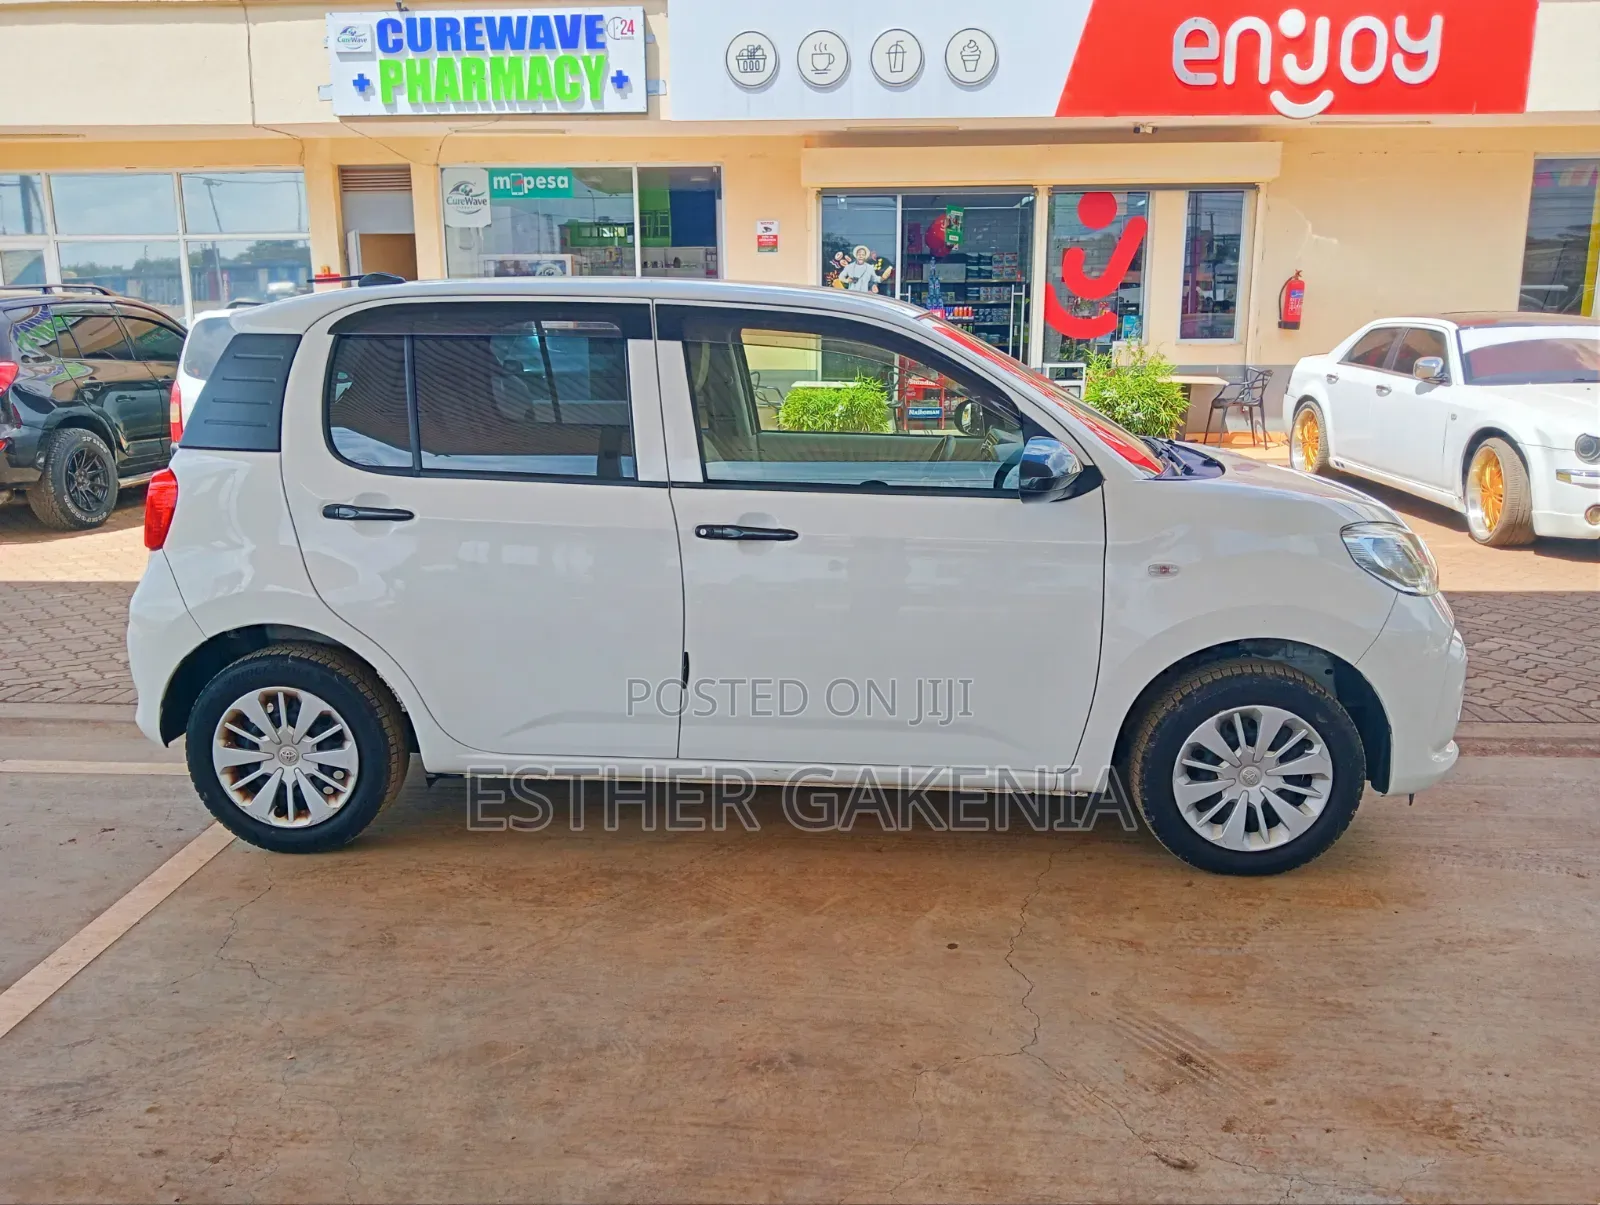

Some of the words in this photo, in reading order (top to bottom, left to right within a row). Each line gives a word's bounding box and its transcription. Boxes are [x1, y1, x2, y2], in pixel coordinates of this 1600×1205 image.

[376, 14, 606, 53] CUREWAVE
[620, 19, 635, 35] 24
[1172, 9, 1444, 86] enjoy
[378, 54, 607, 104] PHARMACY
[446, 196, 488, 206] CureWave
